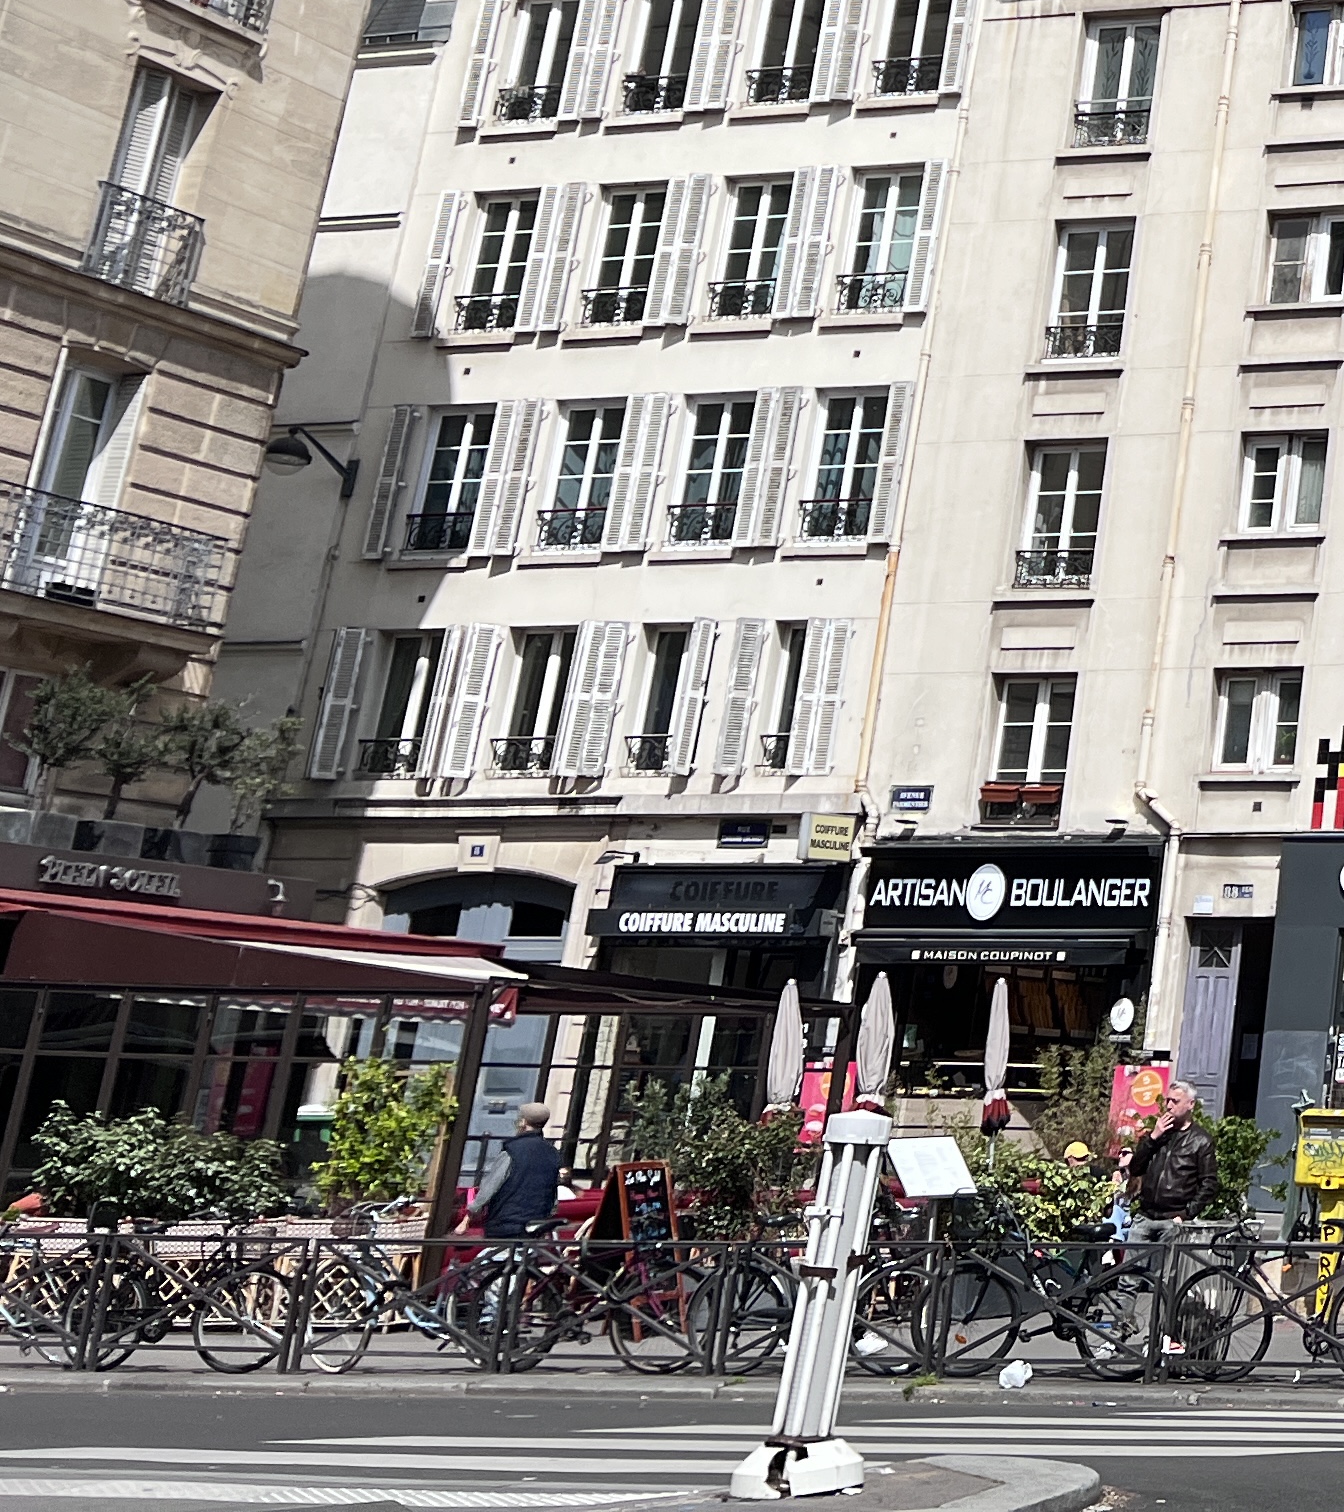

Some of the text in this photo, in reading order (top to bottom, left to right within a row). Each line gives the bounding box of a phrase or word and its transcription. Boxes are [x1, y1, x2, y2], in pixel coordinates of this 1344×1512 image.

[815, 824, 849, 837] COIFFURE
[810, 839, 850, 852] MASCULINE
[669, 880, 779, 902] COIFFURE
[869, 878, 968, 907] ARTISAN
[1009, 878, 1151, 907] BOULANGER
[618, 912, 787, 933] COIFFURE MASCULINE
[923, 950, 1053, 961] MAISON COUPINOT
